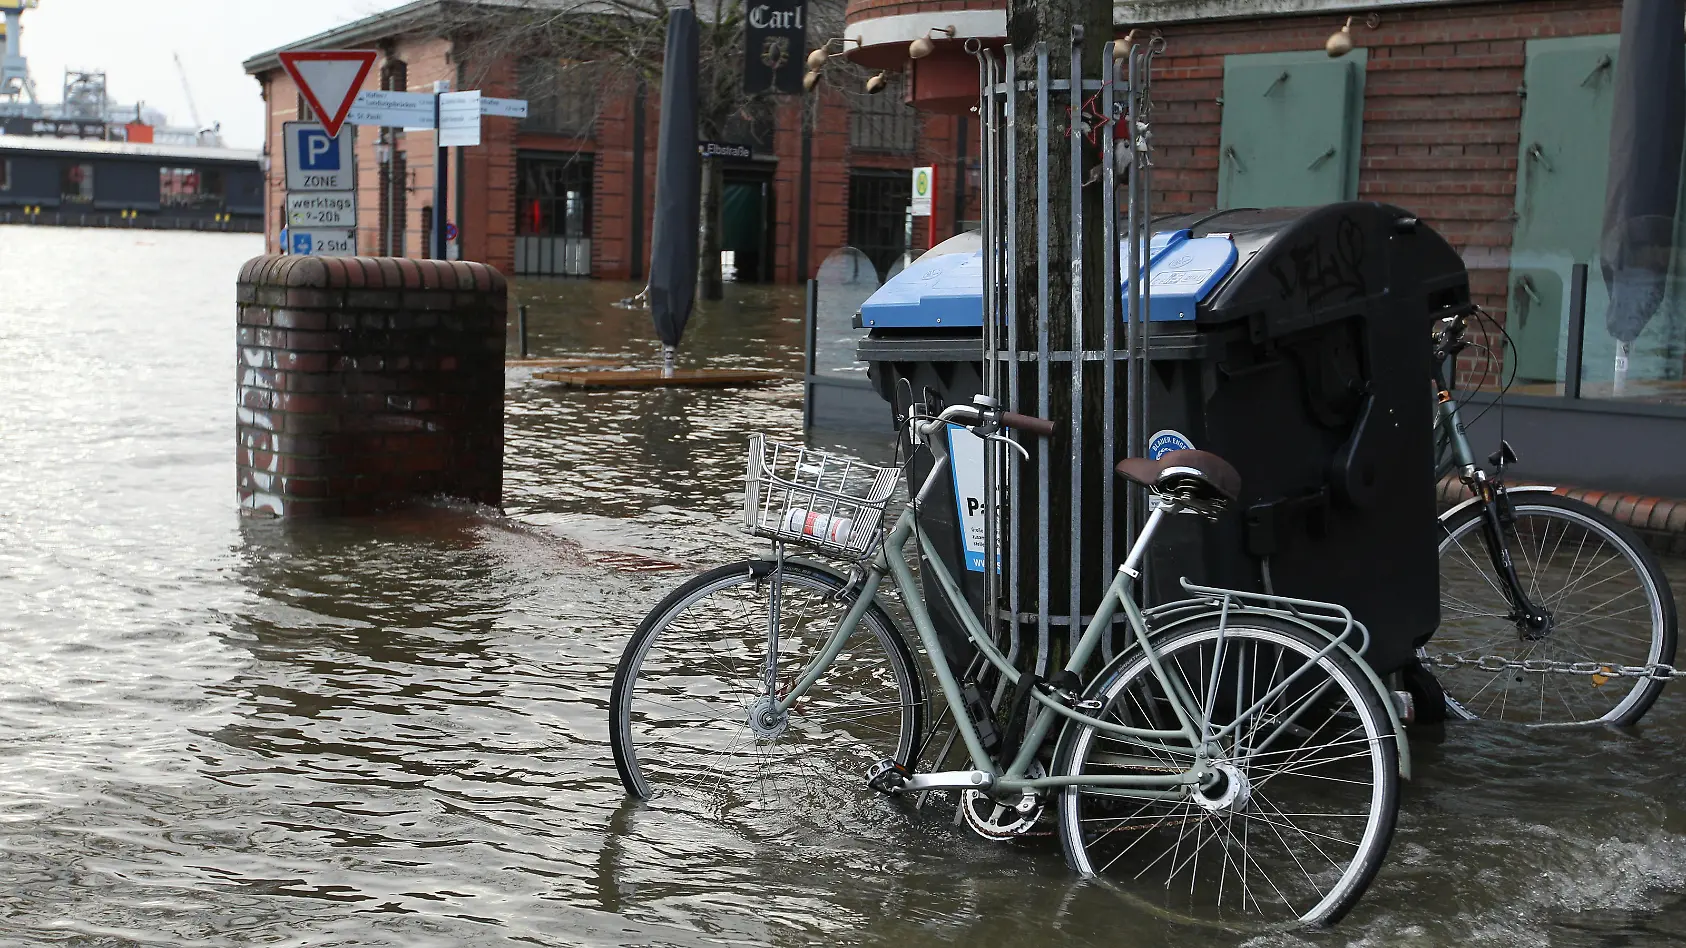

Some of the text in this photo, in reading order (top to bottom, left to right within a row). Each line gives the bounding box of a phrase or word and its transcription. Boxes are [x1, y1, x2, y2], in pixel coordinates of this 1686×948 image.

[749, 4, 803, 29] Carl
[308, 135, 330, 165] P
[707, 143, 750, 158] Elbstraße
[303, 176, 338, 187] ZONE
[293, 197, 351, 210] werktags
[317, 241, 324, 251] 2
[1151, 436, 1187, 452] BLAUER ENGE
[1117, 650, 1145, 673] MARATHO
